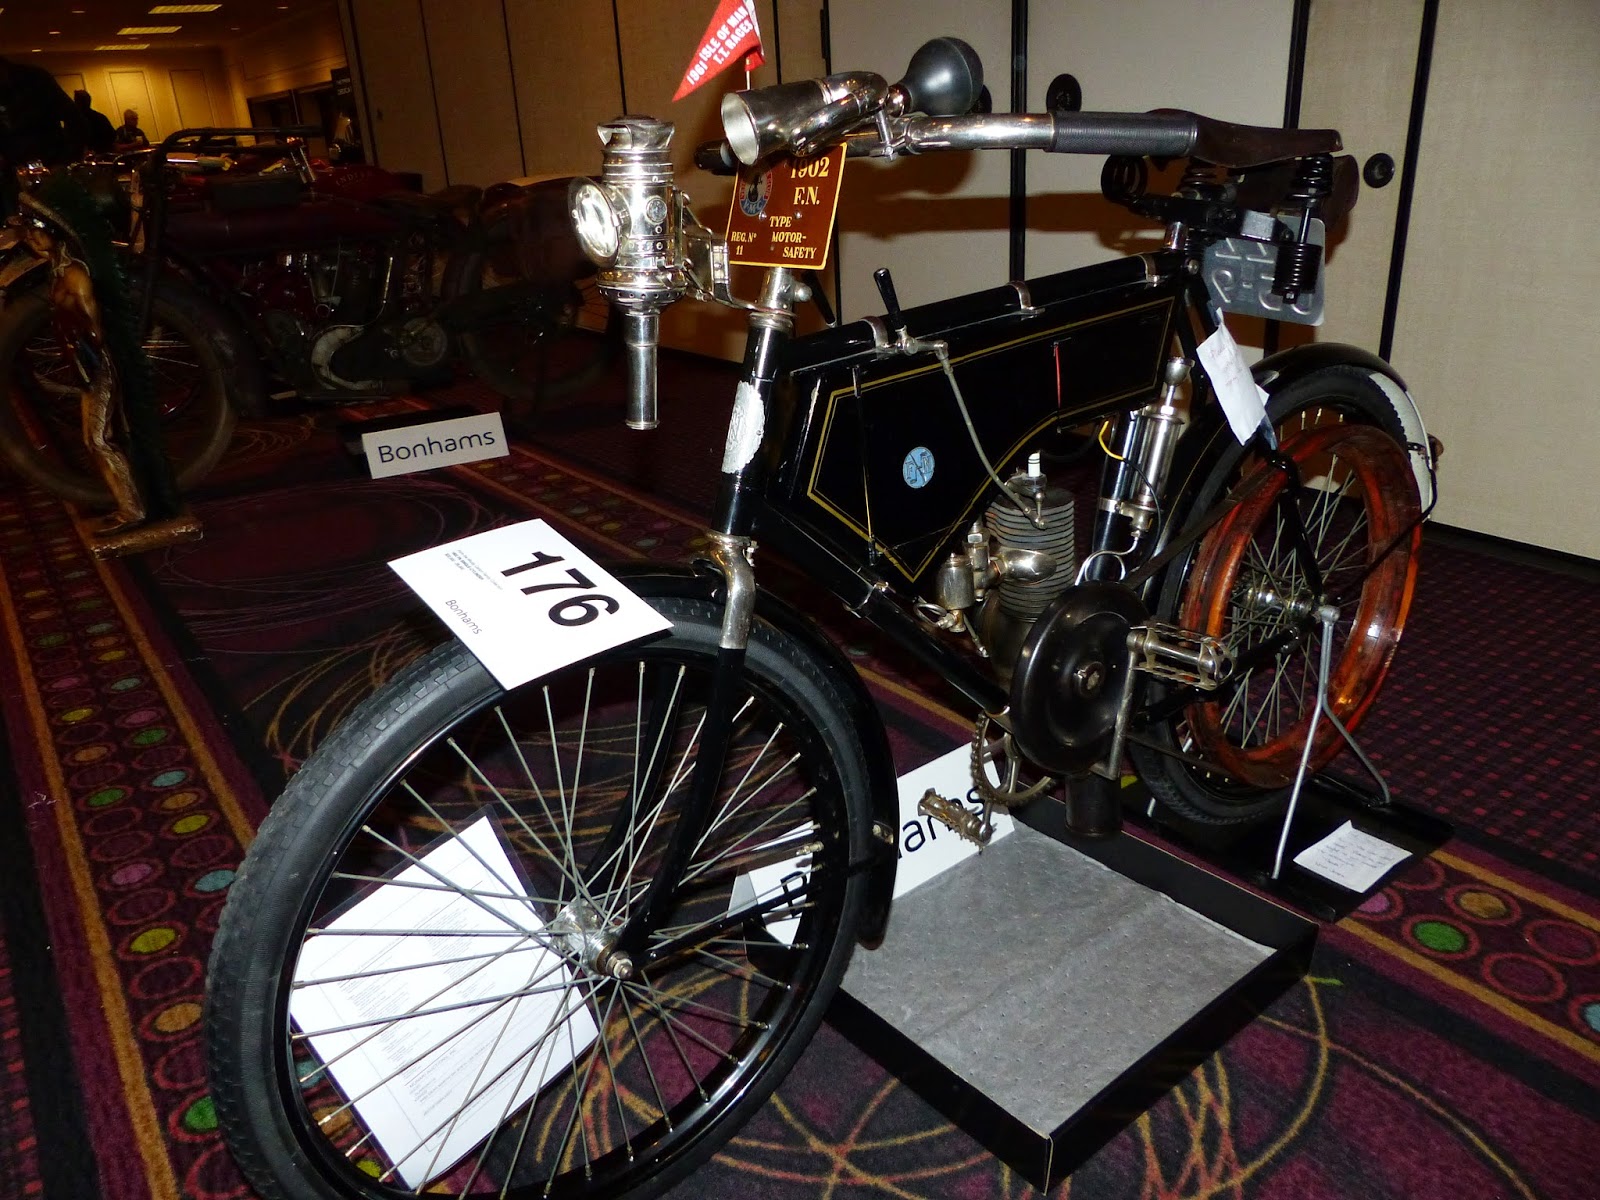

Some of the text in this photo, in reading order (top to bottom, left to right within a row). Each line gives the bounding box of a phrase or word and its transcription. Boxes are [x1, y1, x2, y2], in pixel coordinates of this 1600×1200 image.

[686, 5, 749, 85] 1961 ISLE OF MAN
[712, 19, 754, 65] T.T. RACES
[790, 156, 830, 179] 1902
[793, 186, 820, 205] F.N.
[769, 215, 792, 228] TYPE
[731, 231, 747, 242] REG.
[771, 231, 807, 243] MOTOR-
[735, 245, 744, 256] 11
[782, 246, 817, 259] SAFETY
[378, 431, 496, 464] Bonhams
[500, 551, 620, 627] 176
[445, 599, 483, 635] Bonhams
